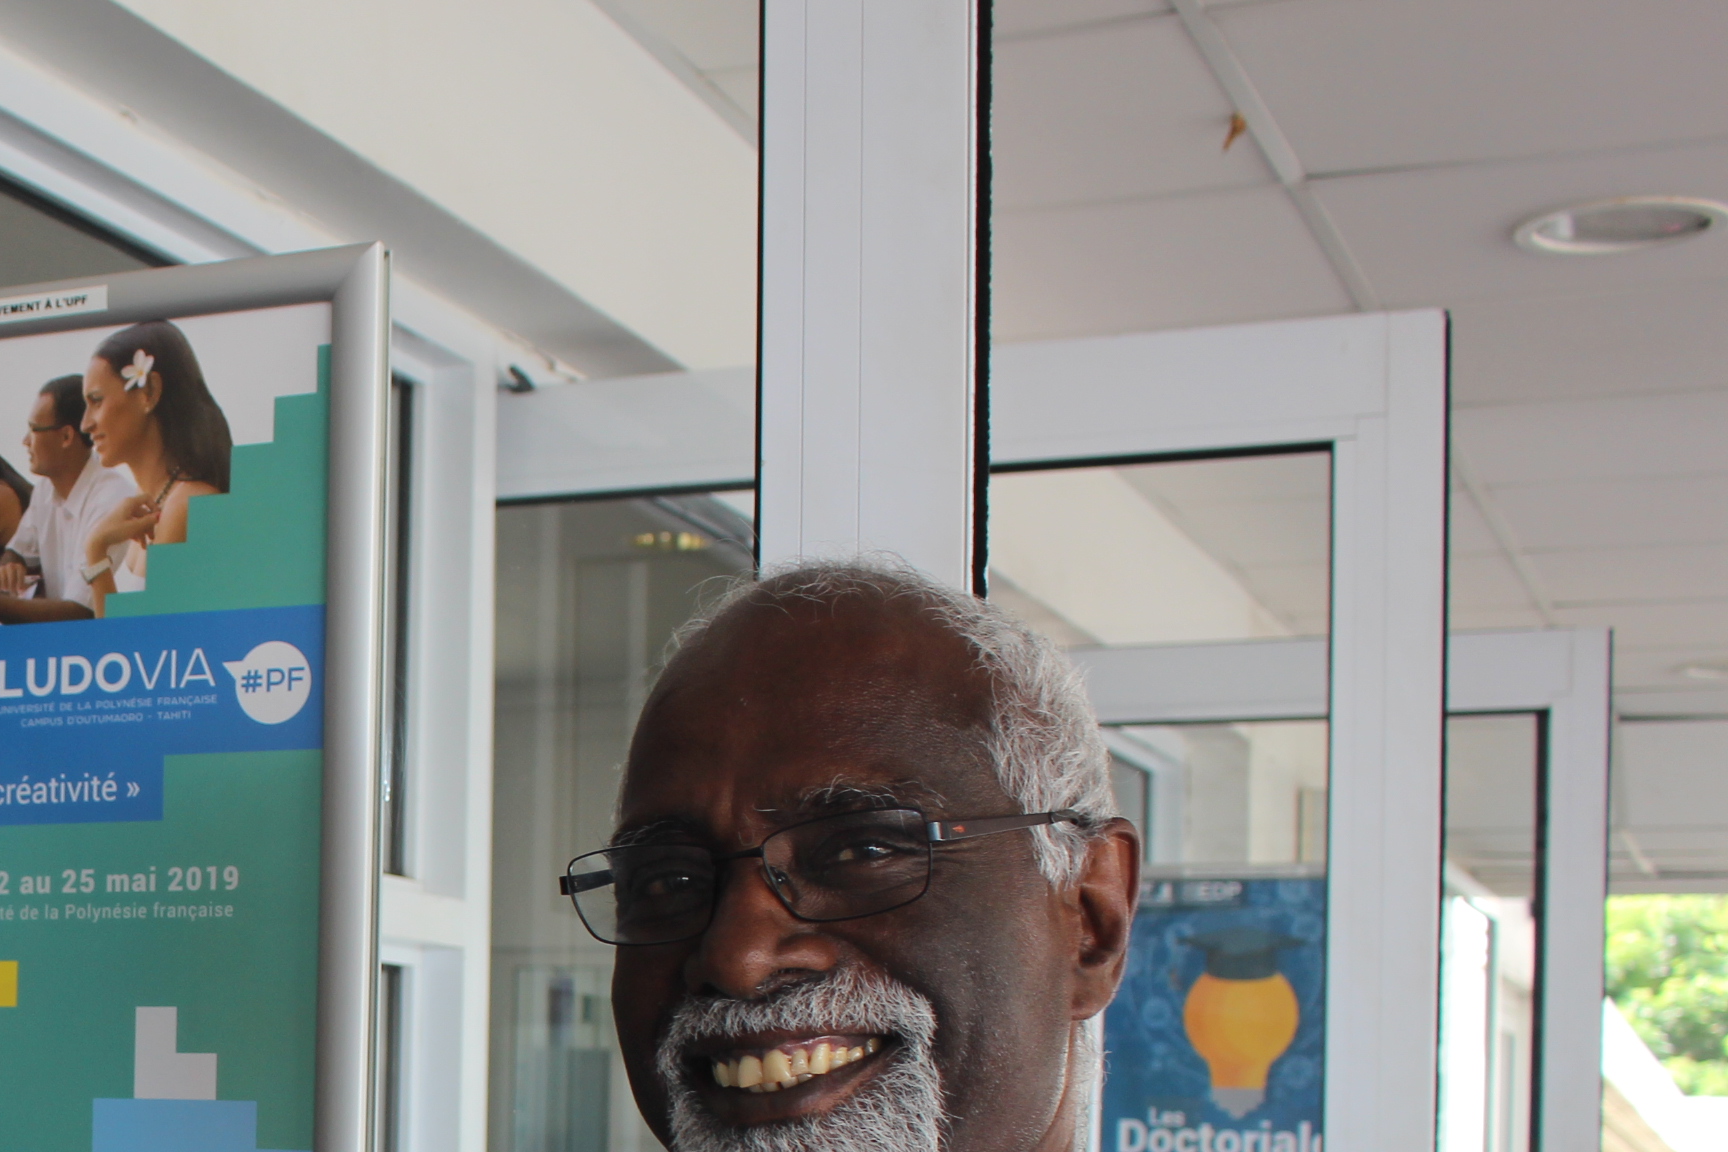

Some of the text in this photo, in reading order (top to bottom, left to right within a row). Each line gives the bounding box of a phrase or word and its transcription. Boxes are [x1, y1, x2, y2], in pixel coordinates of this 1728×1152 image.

[44, 295, 53, 310] À
[55, 294, 89, 308] L'UPF
[240, 665, 305, 694] #PF
[59, 701, 73, 712] DE
[77, 701, 92, 711] LA
[95, 696, 152, 709] POLYNÉSIE
[157, 694, 218, 707] FRANÇAISE
[21, 716, 63, 727] CAMPUS
[157, 710, 192, 720] TAHITI
[19, 874, 51, 894] au
[61, 869, 95, 893] 25
[106, 866, 157, 892] mai
[167, 865, 240, 891] 2019
[20, 903, 39, 920] de
[45, 903, 59, 920] la
[65, 901, 147, 923] Polynésie
[153, 900, 233, 921] française
